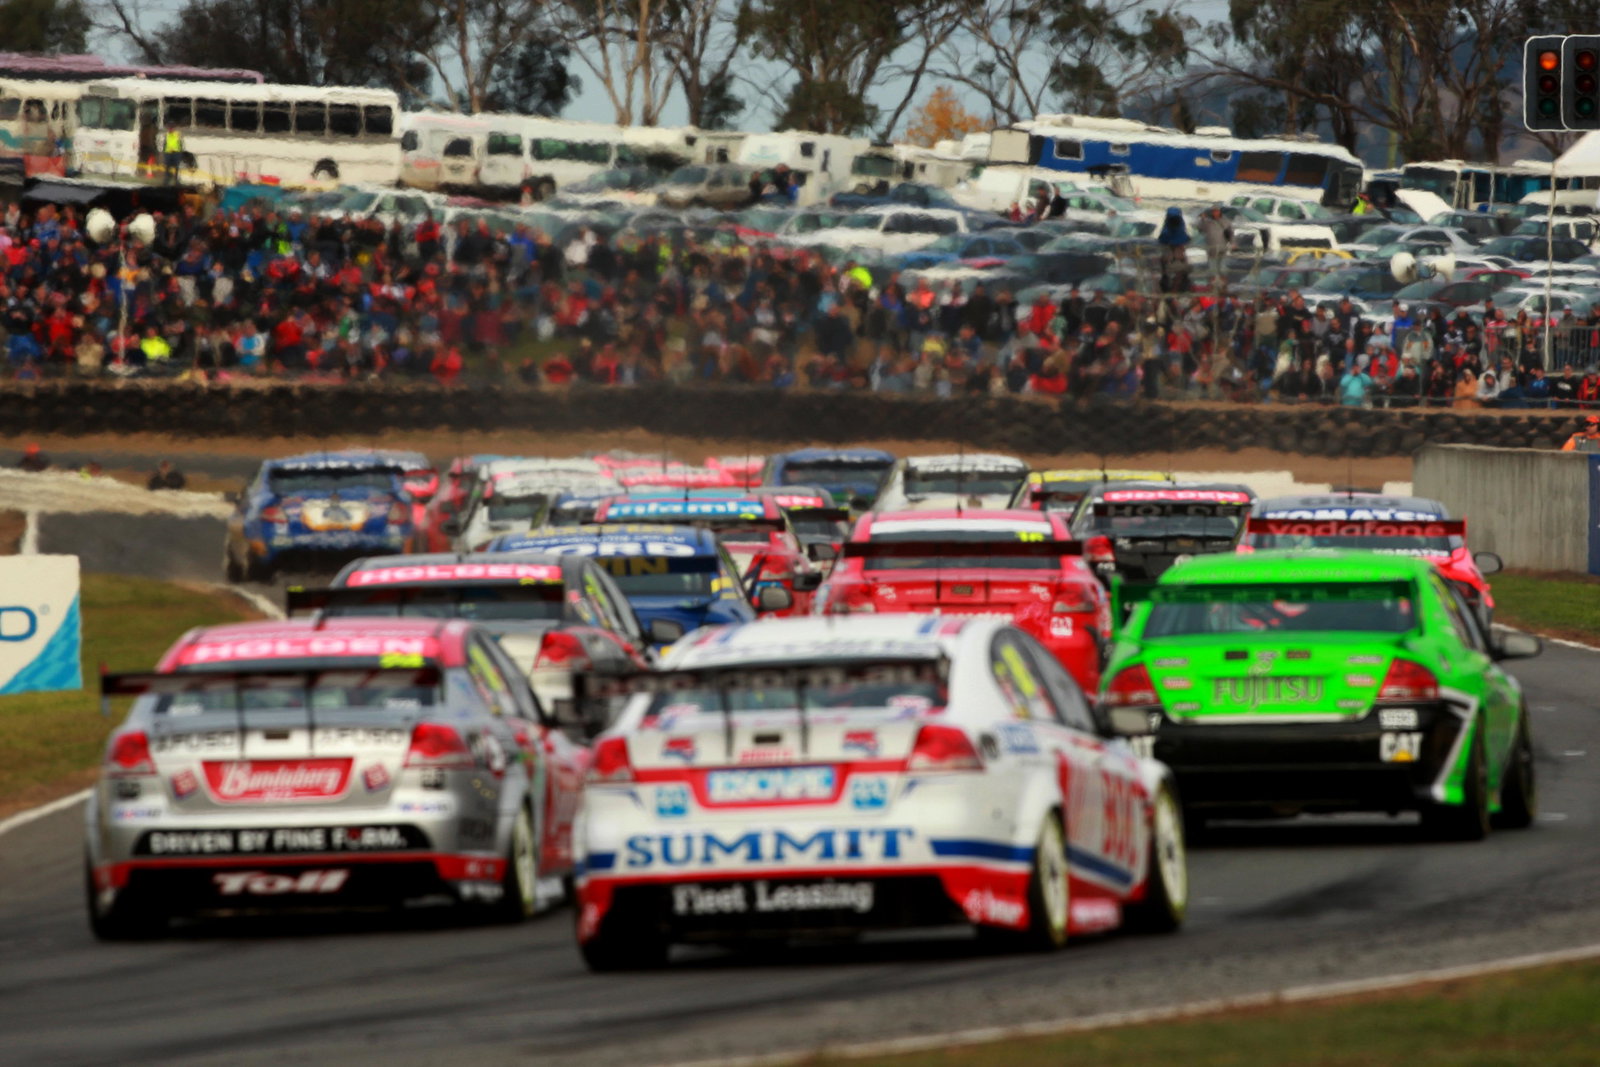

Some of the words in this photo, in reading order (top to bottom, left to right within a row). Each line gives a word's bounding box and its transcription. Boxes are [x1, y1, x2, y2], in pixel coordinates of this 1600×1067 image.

[1110, 491, 1241, 500] HOLDEN
[1268, 520, 1446, 536] vodafone
[512, 542, 695, 557] ORD
[360, 565, 548, 583] HOLDEN
[194, 638, 424, 660] HOLDEN
[1213, 677, 1322, 709] FUJITSU
[1380, 733, 1422, 761] CAT
[151, 831, 232, 853] DRIVEN
[238, 830, 268, 851] BY
[274, 828, 324, 850] FINE
[627, 828, 914, 866] SUMMIT
[213, 868, 349, 894] Toll
[674, 883, 747, 914] Fleet
[755, 877, 873, 913] Leasing
